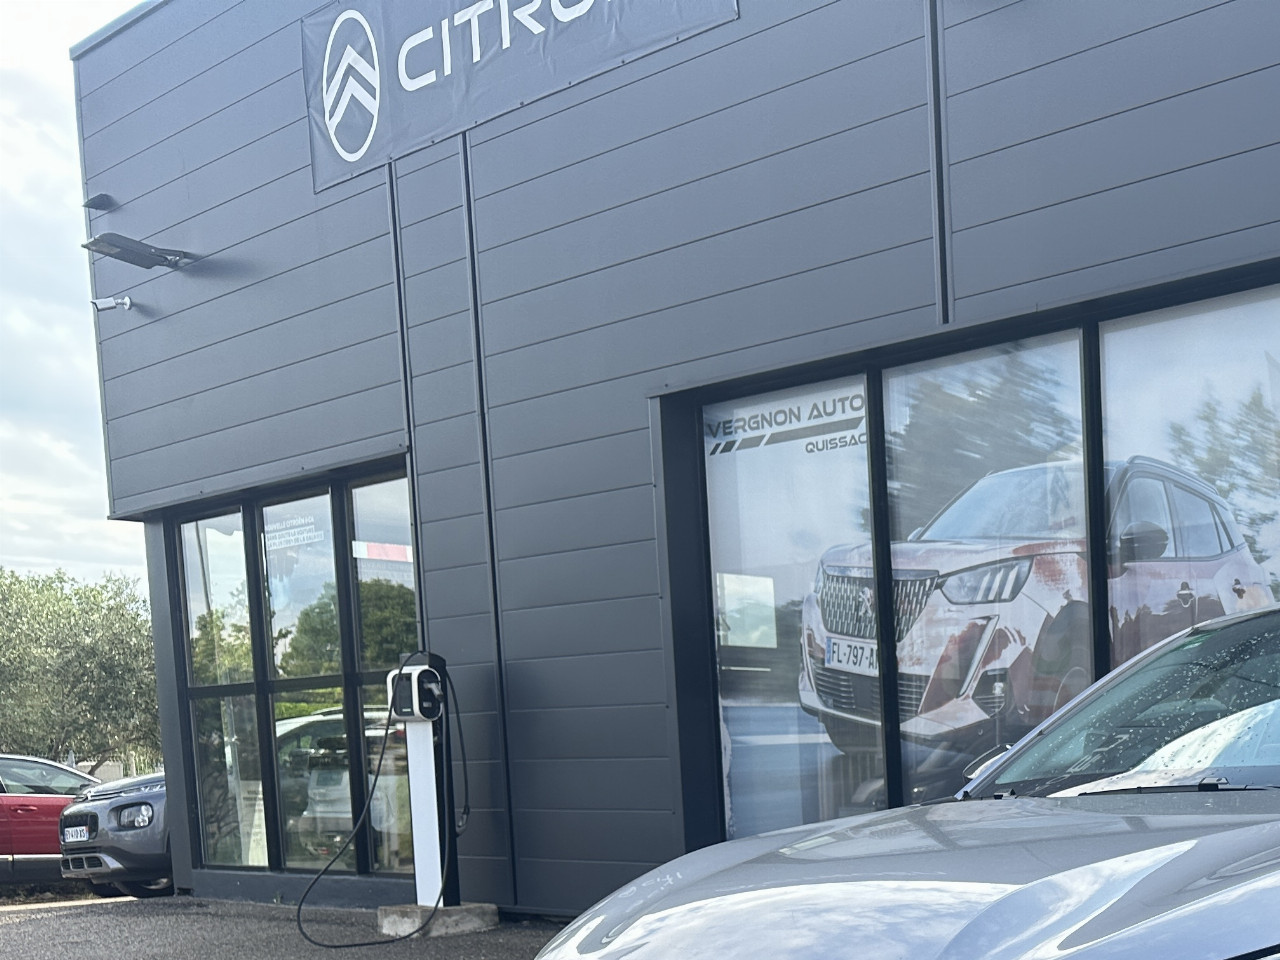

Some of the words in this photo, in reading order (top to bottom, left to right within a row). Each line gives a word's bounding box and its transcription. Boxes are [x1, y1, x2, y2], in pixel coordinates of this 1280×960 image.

[707, 406, 801, 438] VERGNON
[807, 393, 865, 421] AUTO
[805, 433, 868, 454] QUISSAC
